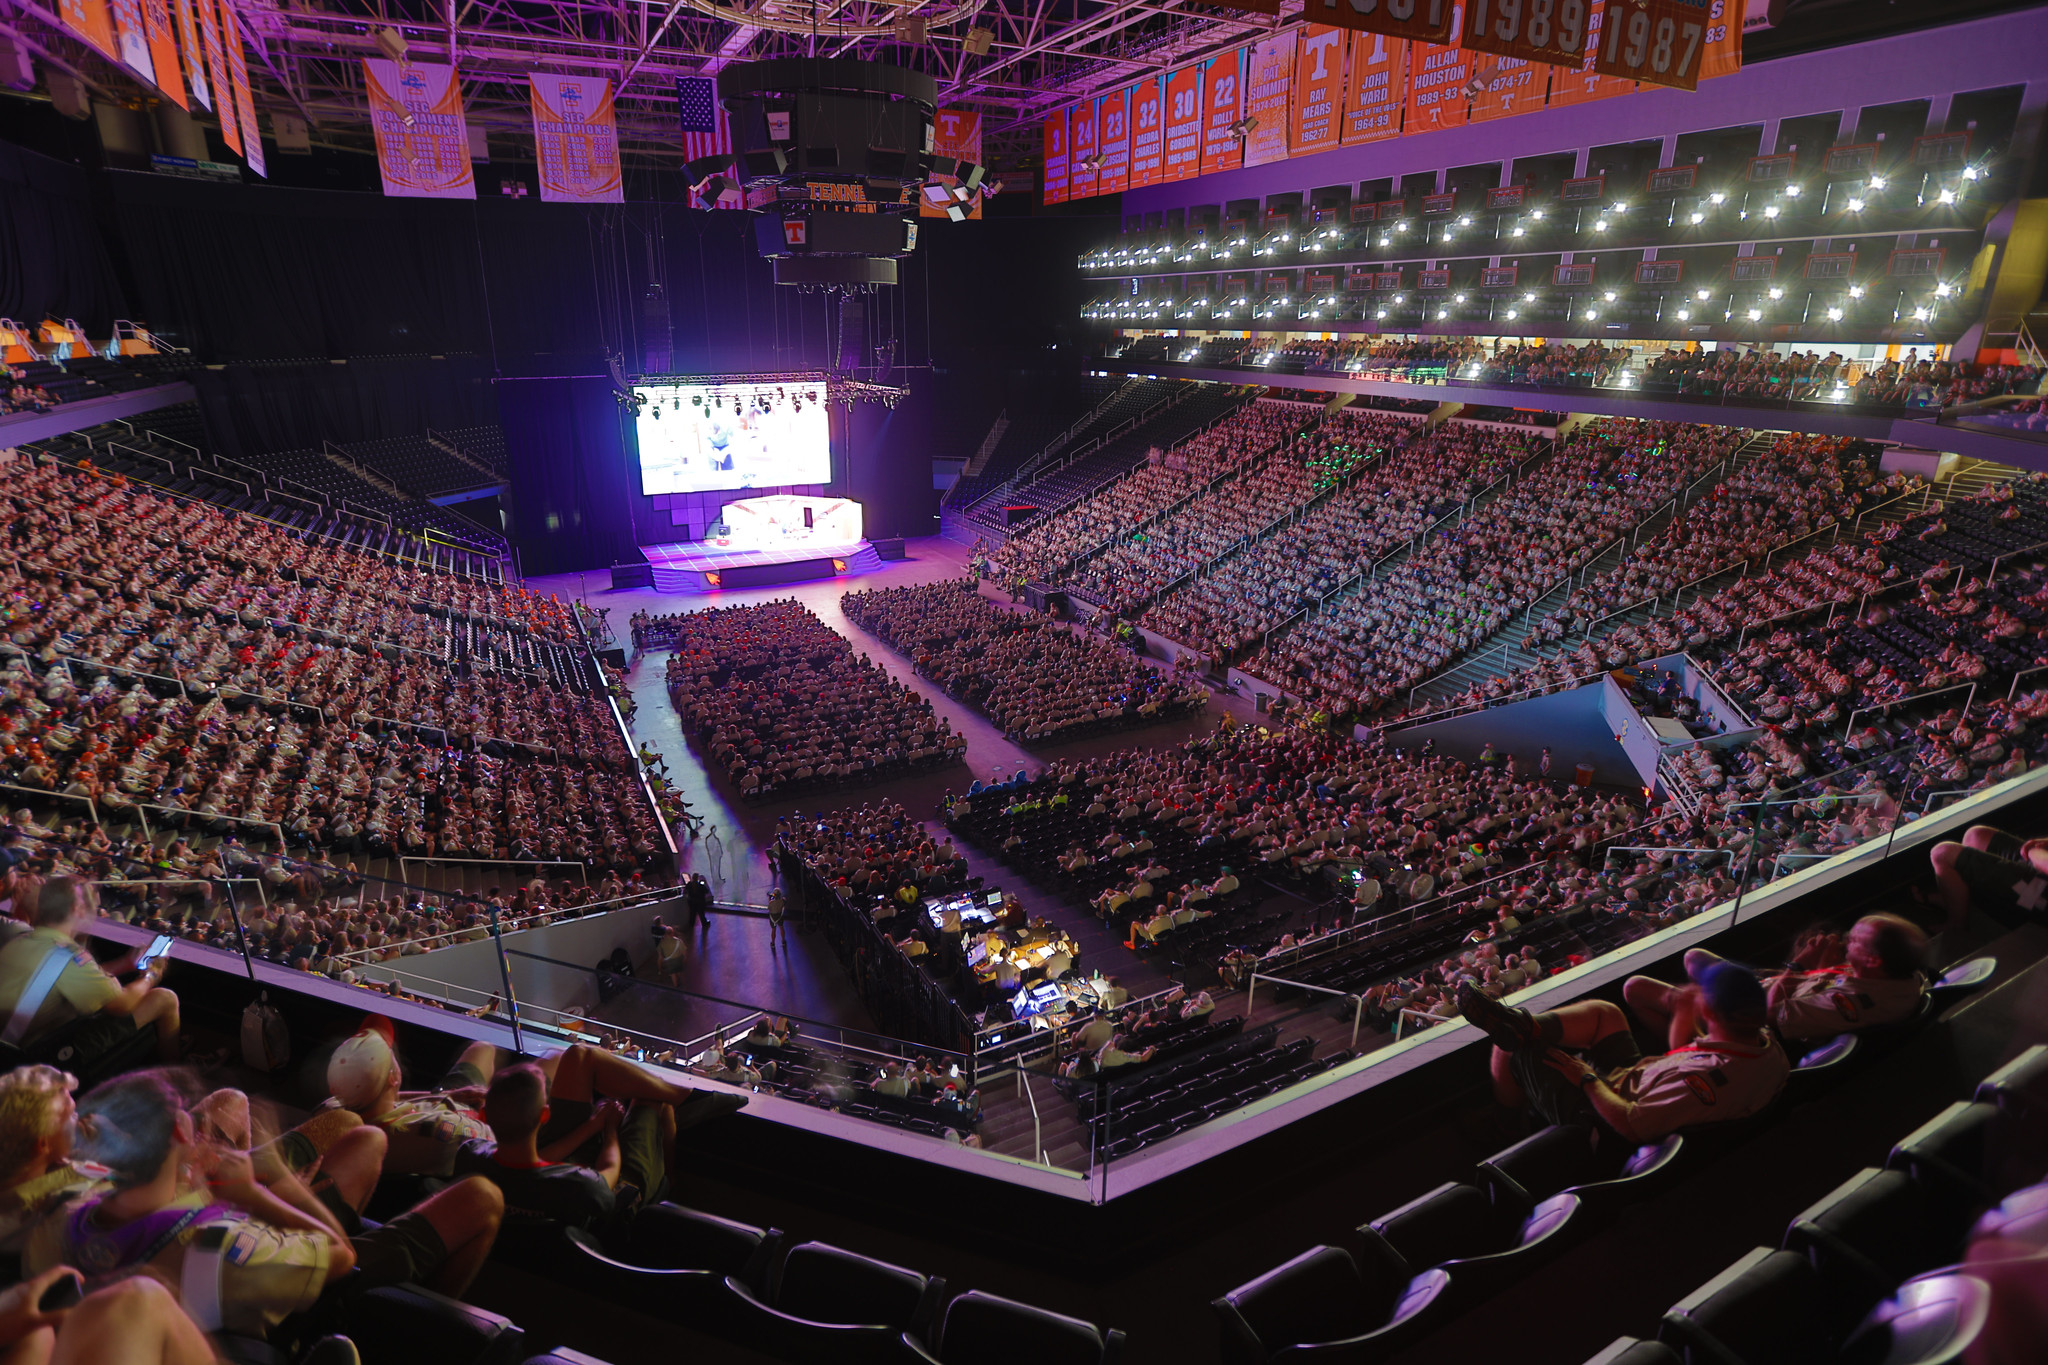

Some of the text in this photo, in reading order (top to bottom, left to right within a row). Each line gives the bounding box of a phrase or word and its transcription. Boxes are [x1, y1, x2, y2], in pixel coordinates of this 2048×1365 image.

[1473, 0, 1583, 54] 1989
[1605, 5, 1702, 79] 1987
[1307, 30, 1339, 81] T
[1425, 49, 1459, 71] ALLAN
[1264, 65, 1280, 82] PAT
[1362, 71, 1389, 90] JOHN
[1415, 65, 1466, 90] HOUSTON
[1489, 72, 1533, 93] 1974-77
[1215, 75, 1235, 109] 22
[1585, 76, 1600, 93] T
[1175, 89, 1195, 120] 30
[1310, 88, 1327, 104] RAY
[1361, 88, 1388, 106] WARD
[1417, 87, 1458, 107] 1989-93
[1502, 94, 1515, 110] T
[405, 101, 430, 113] SEC
[1140, 99, 1157, 129] 32
[1303, 103, 1331, 120] MEARS
[1430, 108, 1441, 123] T
[378, 110, 458, 126] TOUNAMENT
[563, 112, 584, 123] SEC
[941, 115, 960, 137] T
[1107, 111, 1123, 140] 23
[1213, 110, 1234, 127] HOLLY
[1354, 115, 1389, 132] 1964-99
[540, 122, 610, 136] CHAMPIONS
[1078, 119, 1093, 146] 24
[1302, 127, 1328, 143] 1962-77
[1053, 129, 1061, 153] 3
[1170, 135, 1196, 151] GORDON
[807, 182, 910, 205] TENNEE
[786, 223, 803, 242] T
